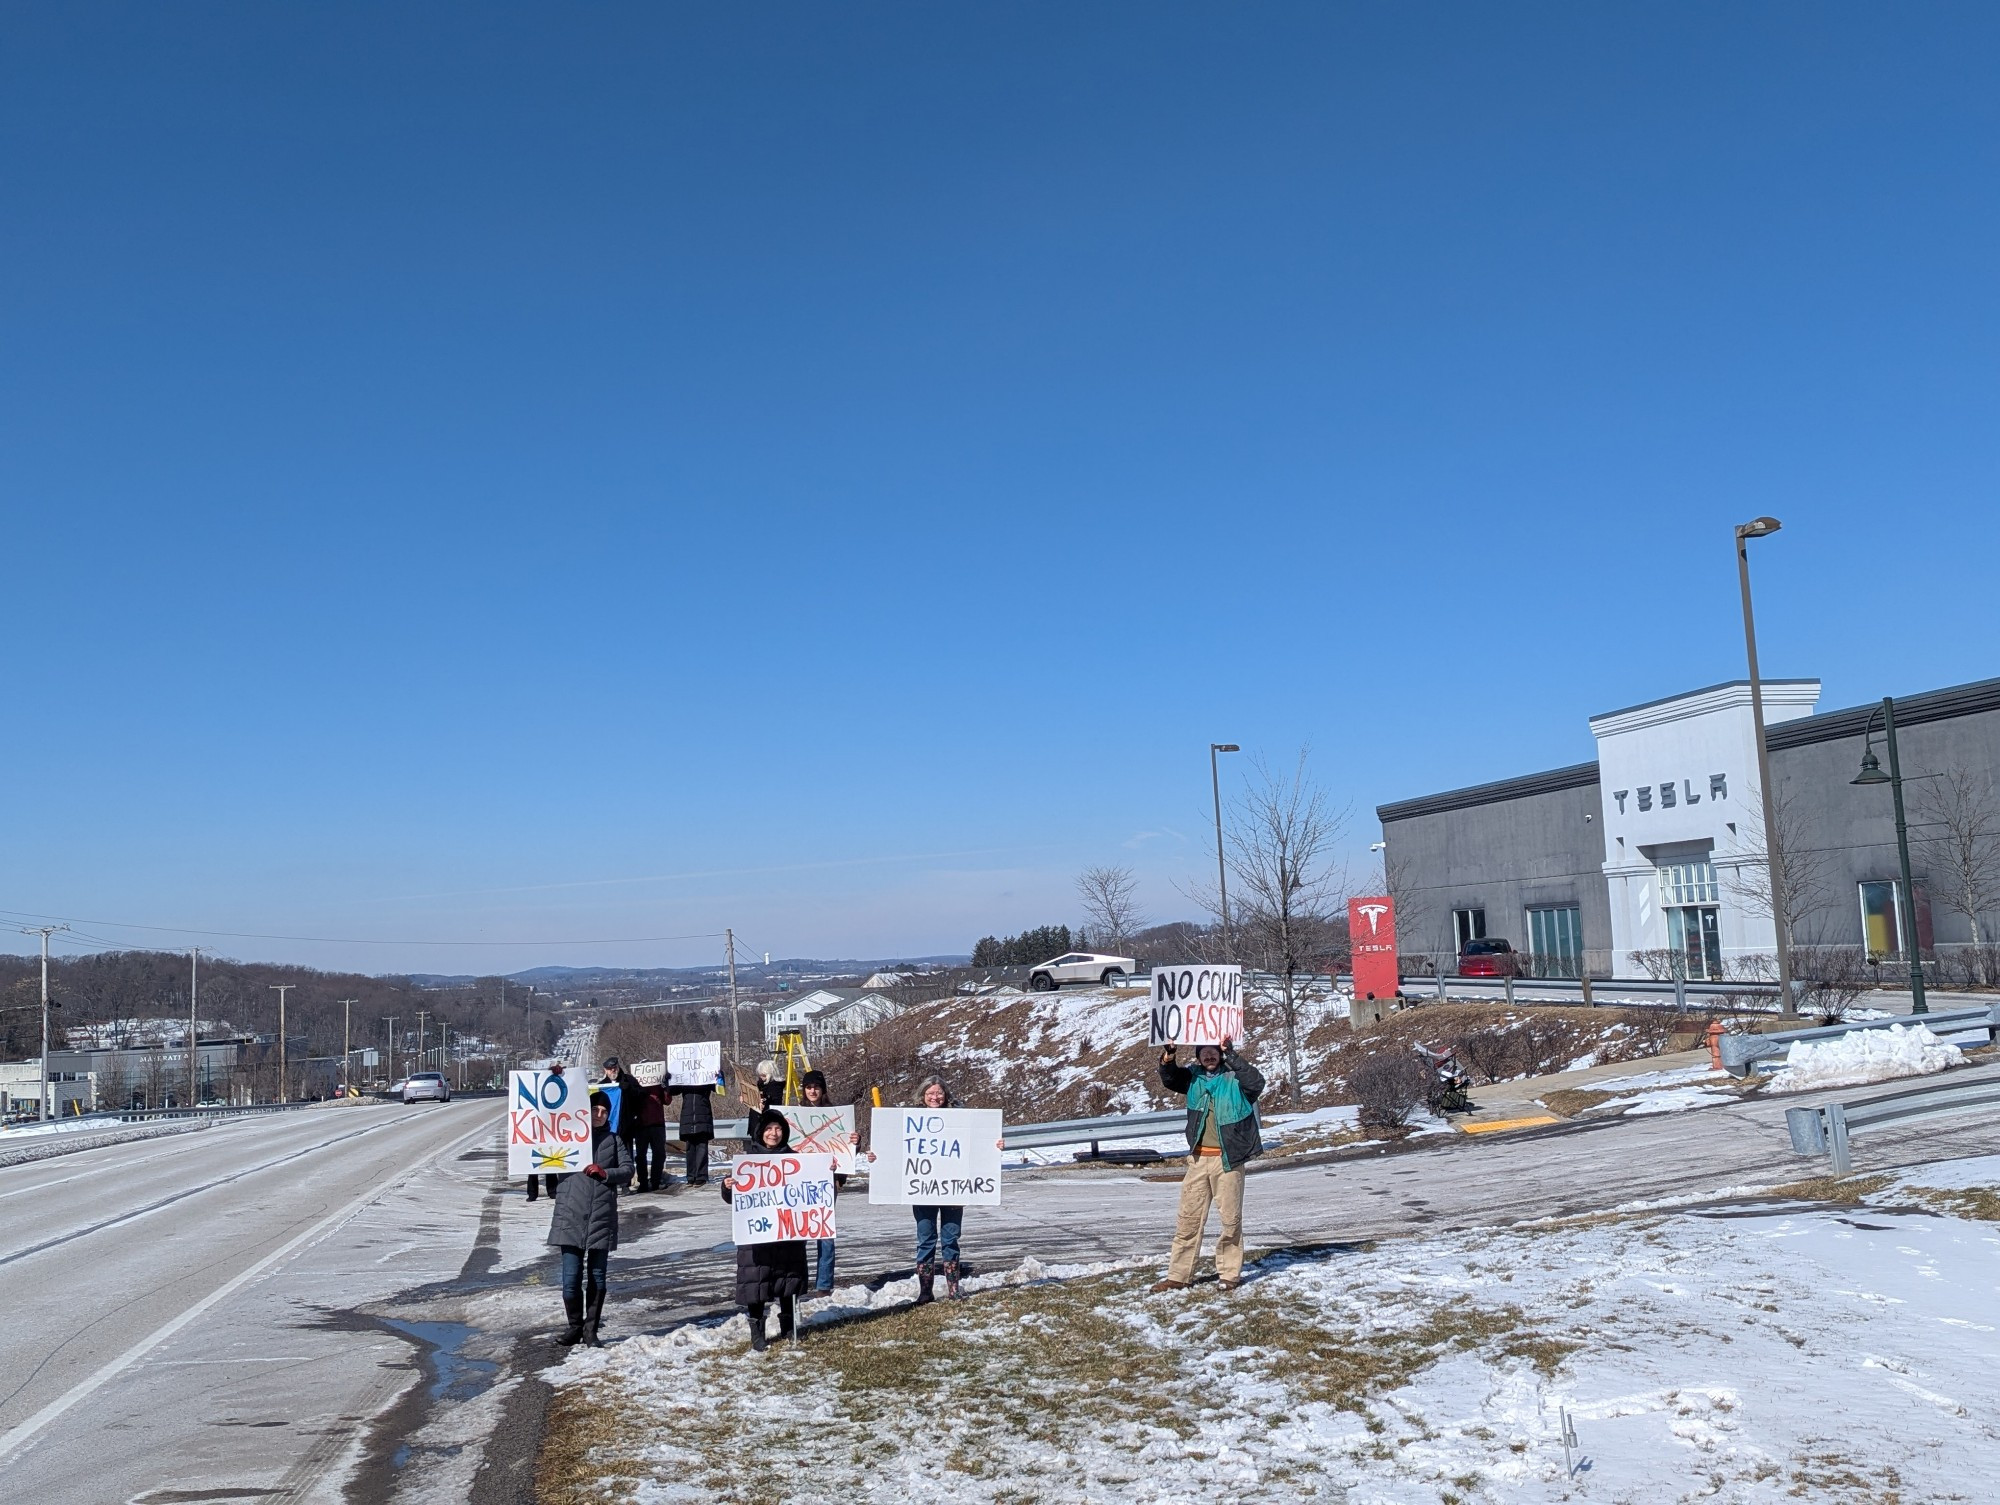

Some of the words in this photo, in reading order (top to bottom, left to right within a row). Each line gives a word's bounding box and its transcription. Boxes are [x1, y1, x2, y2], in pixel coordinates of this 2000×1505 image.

[1612, 772, 1728, 816] TESLA
[1359, 944, 1392, 952] TESLA
[1157, 970, 1194, 1002] NO
[1197, 970, 1242, 1005] COUP
[1150, 1004, 1182, 1044] NO
[1185, 1003, 1243, 1043] FASCISM
[139, 1054, 181, 1063] MAERATI
[669, 1046, 695, 1061] KEEP
[697, 1043, 720, 1058] YOUR
[634, 1064, 662, 1075] FIGHT
[682, 1058, 705, 1072] MUSK
[689, 1071, 701, 1084] MY
[516, 1072, 568, 1112] NO
[511, 1109, 590, 1144] KINGS
[906, 1115, 945, 1134] NO
[904, 1138, 961, 1159] TESLA
[735, 1157, 801, 1192] STOP
[905, 1158, 932, 1175] NO
[734, 1189, 784, 1212] FEDERAL
[783, 1179, 834, 1208] CONTRACTS
[748, 1216, 773, 1235] FOR
[777, 1206, 835, 1241] MUSK
